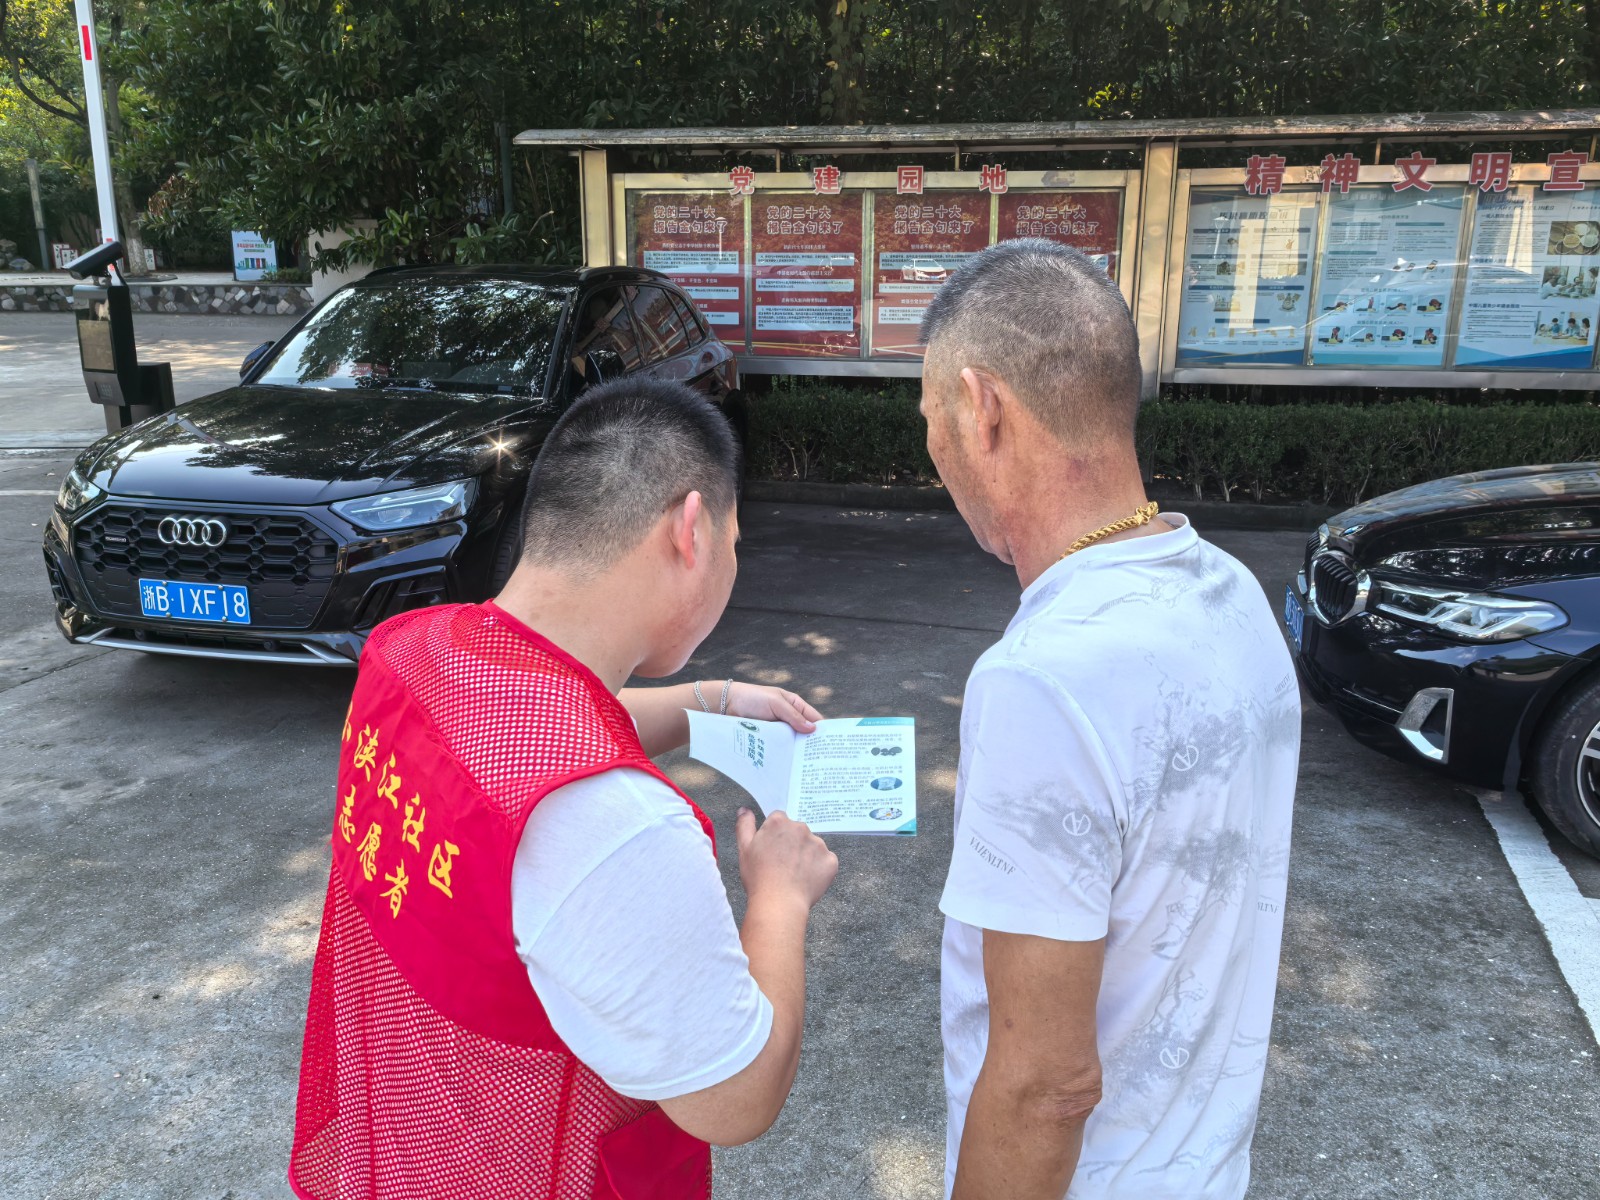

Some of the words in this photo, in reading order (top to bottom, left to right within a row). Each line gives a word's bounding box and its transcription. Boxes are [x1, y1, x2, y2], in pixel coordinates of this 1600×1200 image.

[729, 164, 1008, 195] 党建园地
[654, 205, 716, 219] 党的二十大
[767, 205, 832, 219] 党的二十大
[894, 205, 962, 219] 党的二十大
[1016, 205, 1087, 219] 党的二十大
[654, 220, 728, 234] 报告金句来了
[767, 220, 844, 235] 报告金句来了
[894, 220, 974, 235] 报告金句来了
[1016, 220, 1100, 236] 报告金句来了
[339, 783, 410, 920] 志愿者
